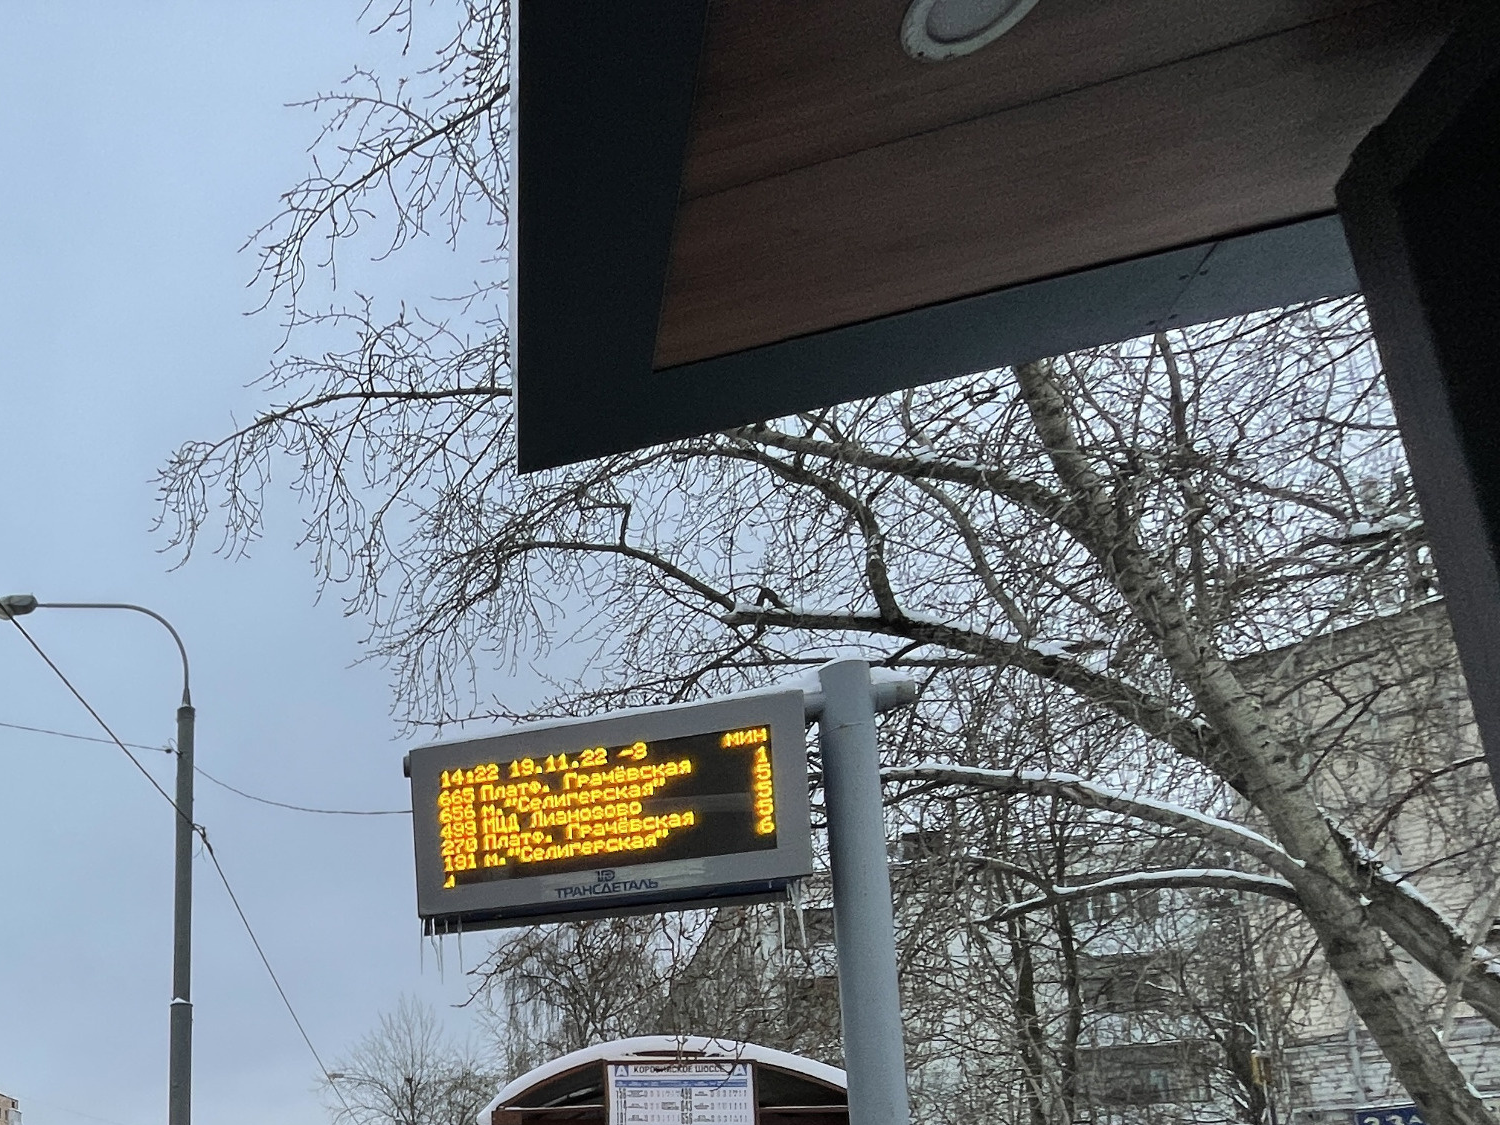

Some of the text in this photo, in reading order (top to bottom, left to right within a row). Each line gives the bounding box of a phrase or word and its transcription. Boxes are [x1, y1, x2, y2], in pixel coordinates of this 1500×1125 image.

[438, 746, 768, 808] 665 Платф. Грачёвская 1
[439, 804, 476, 824] 656
[504, 777, 666, 813] "Селигерская"
[755, 763, 771, 780] 5
[441, 764, 499, 788] 14:22
[509, 748, 608, 778] 19.11.22
[440, 780, 773, 840] 499 МЦД Лианозово 5
[441, 798, 774, 857] 270 Платф. Грачёвская 5
[507, 829, 669, 863] "Селигерская"
[758, 816, 775, 835] 6
[555, 879, 659, 899] ТРАНСДЕТАЛЬ
